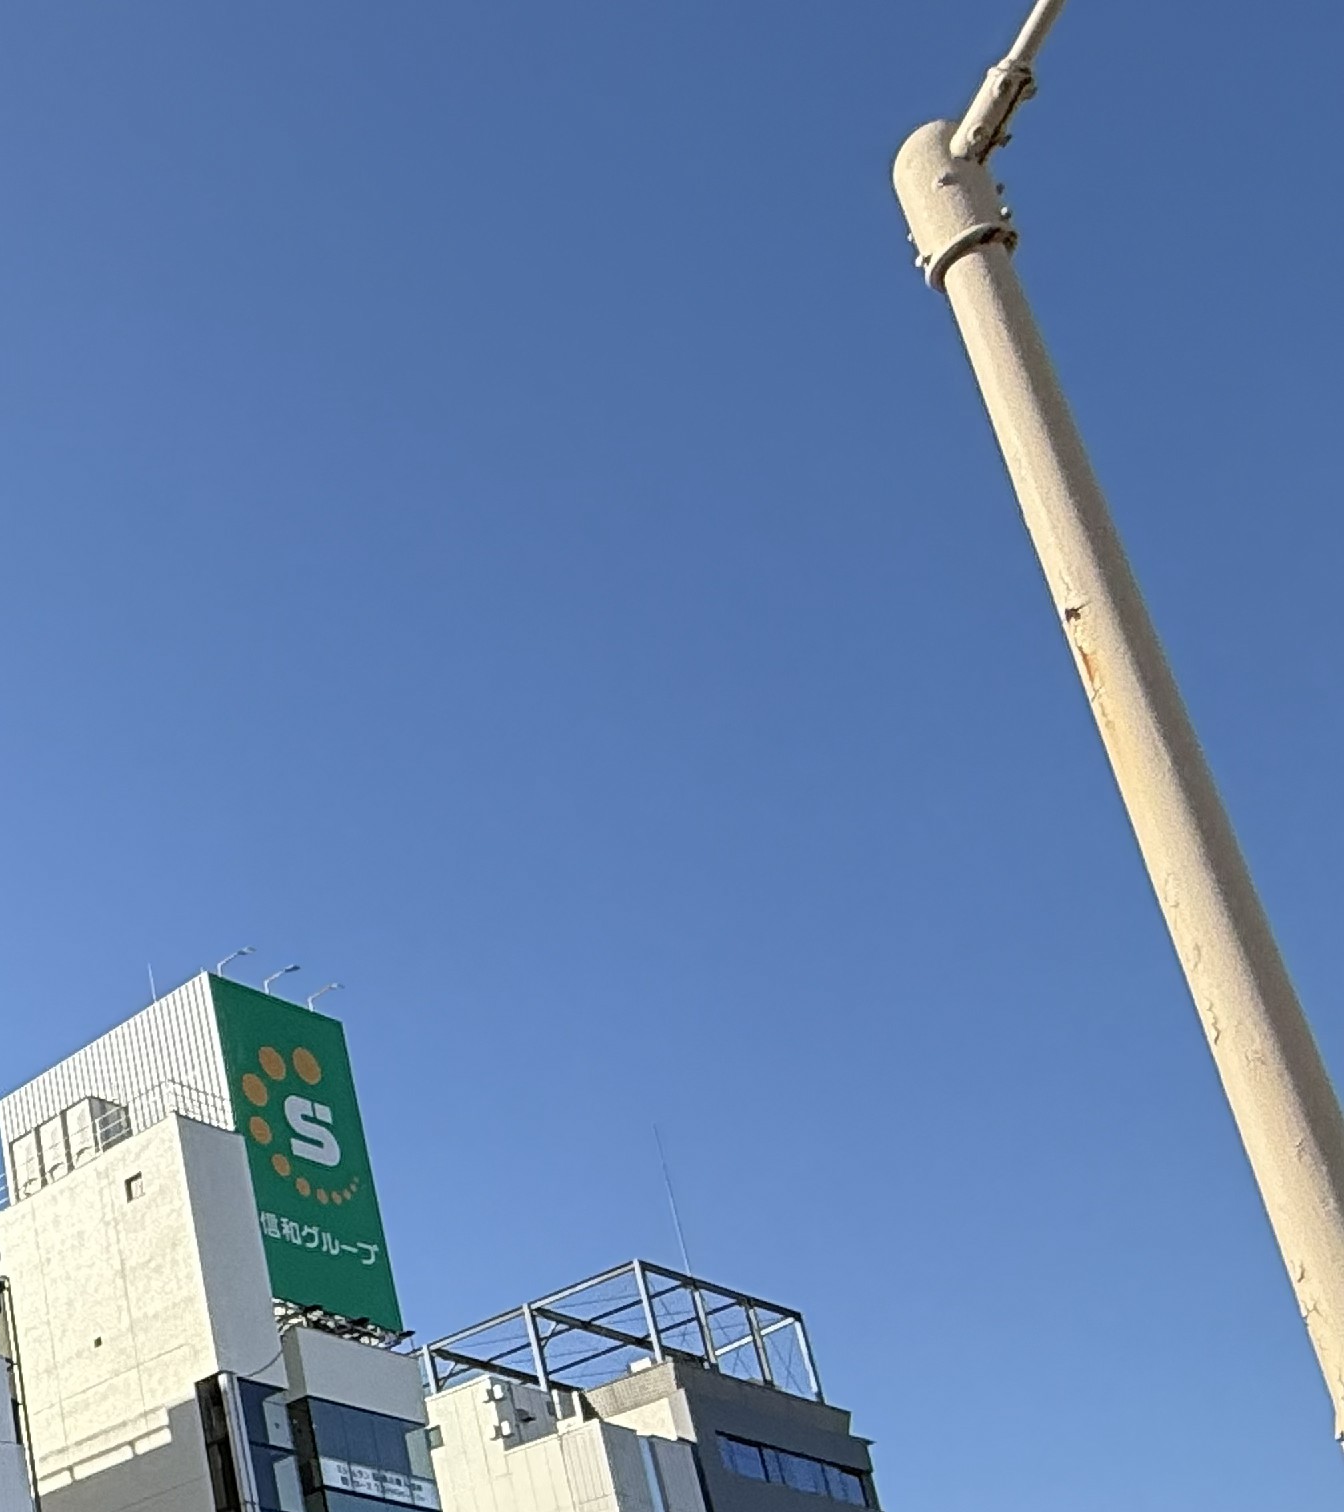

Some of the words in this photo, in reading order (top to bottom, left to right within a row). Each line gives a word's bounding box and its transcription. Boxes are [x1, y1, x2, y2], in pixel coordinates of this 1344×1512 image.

[259, 1210, 379, 1265] 信和グループ
